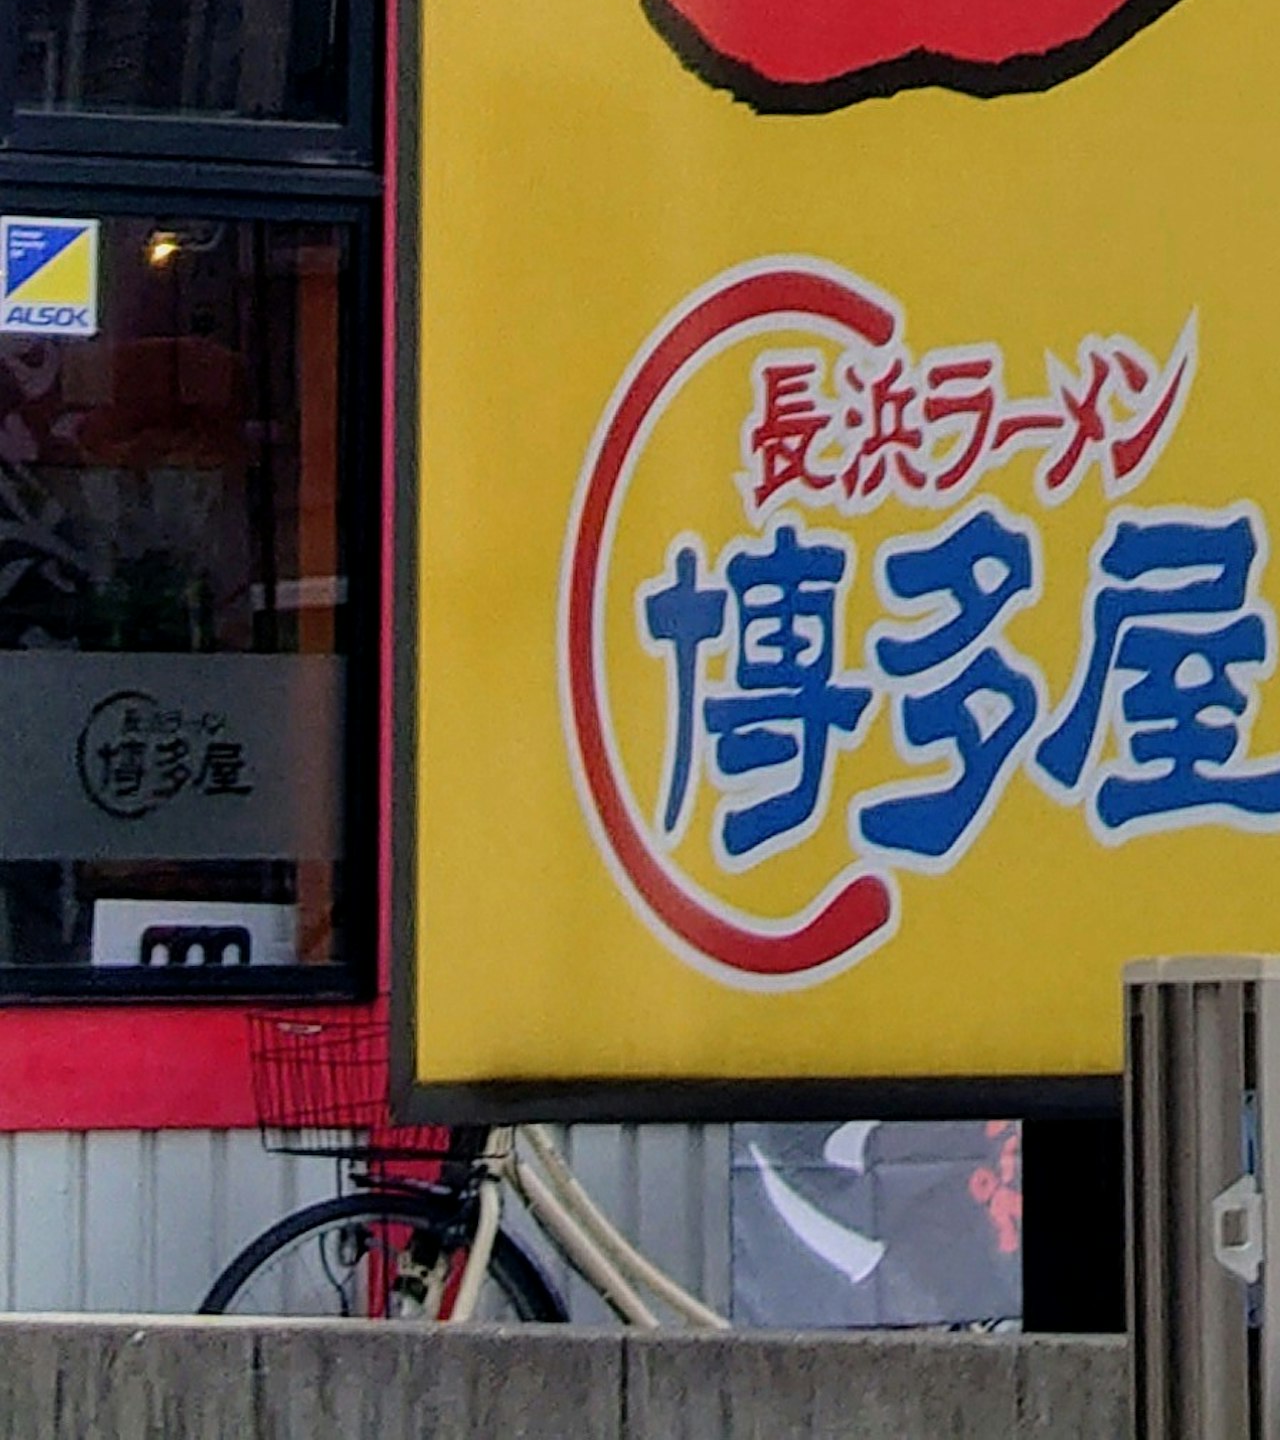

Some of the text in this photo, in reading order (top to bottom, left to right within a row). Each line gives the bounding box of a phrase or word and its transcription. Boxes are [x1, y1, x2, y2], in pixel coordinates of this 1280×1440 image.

[6, 306, 89, 328] ALSOK
[749, 340, 1192, 510] 長浜ラーメン
